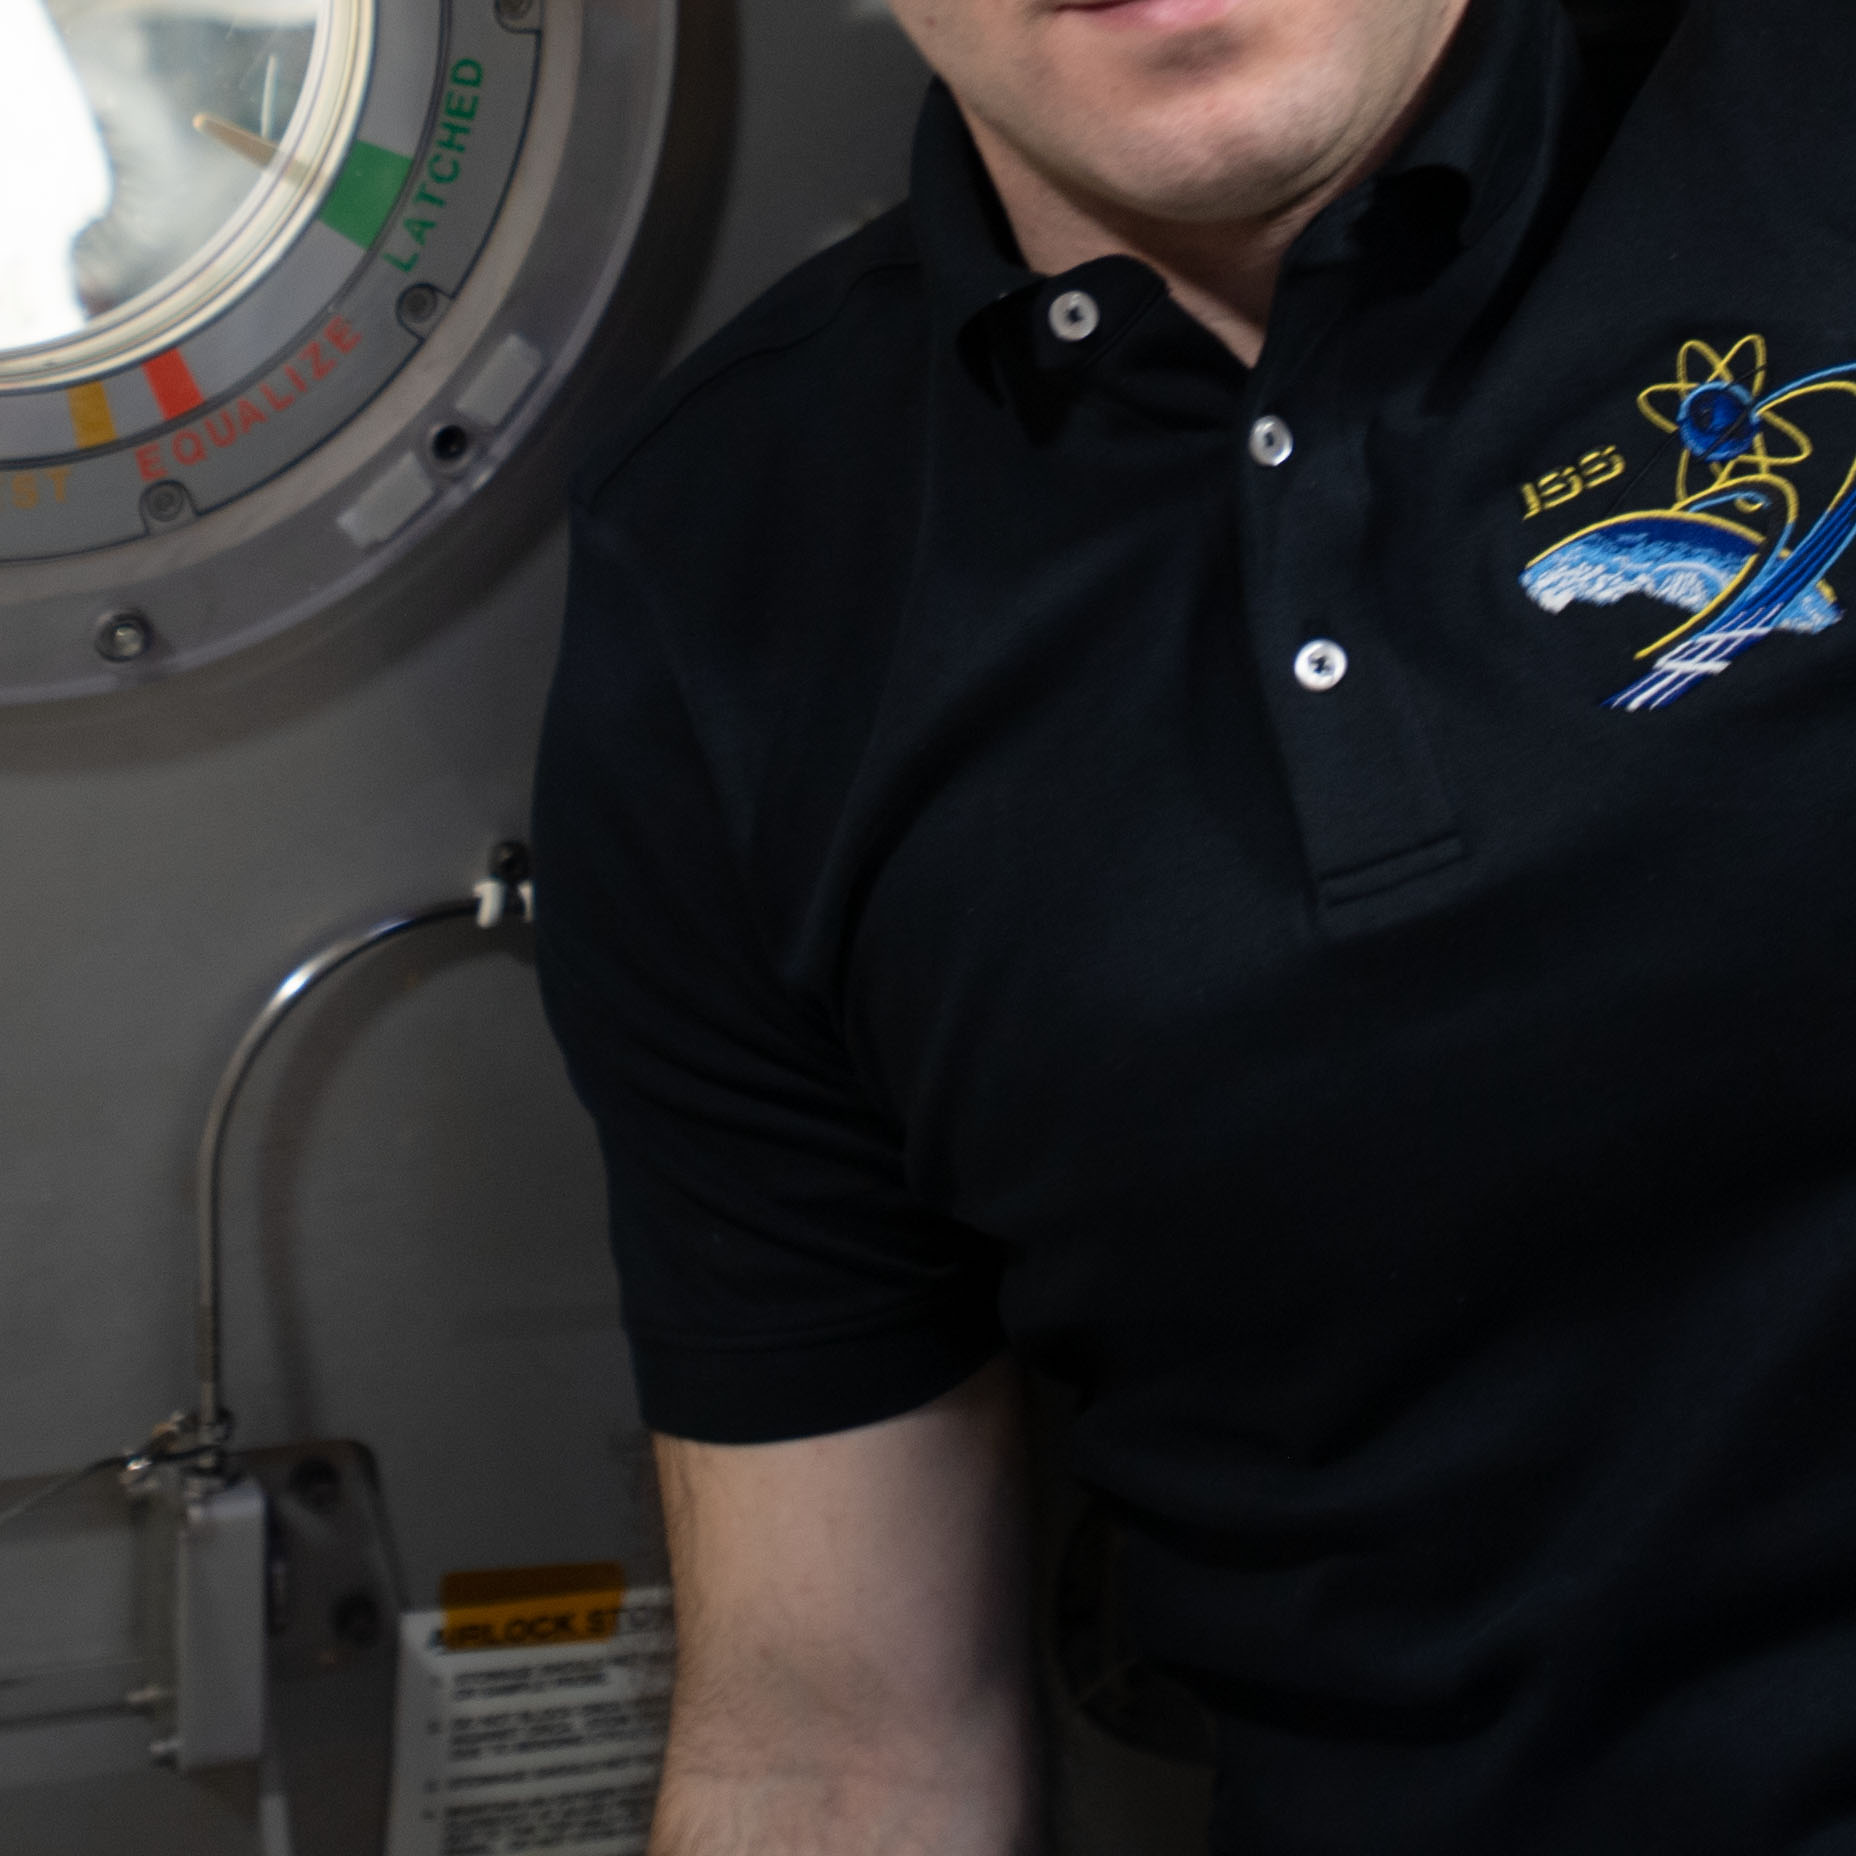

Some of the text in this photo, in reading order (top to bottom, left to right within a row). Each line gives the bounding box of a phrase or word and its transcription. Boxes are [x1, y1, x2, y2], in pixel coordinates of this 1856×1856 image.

[380, 57, 484, 273] LATCHED
[133, 313, 365, 483] EQUALIZE
[1519, 444, 1626, 521] ISS
